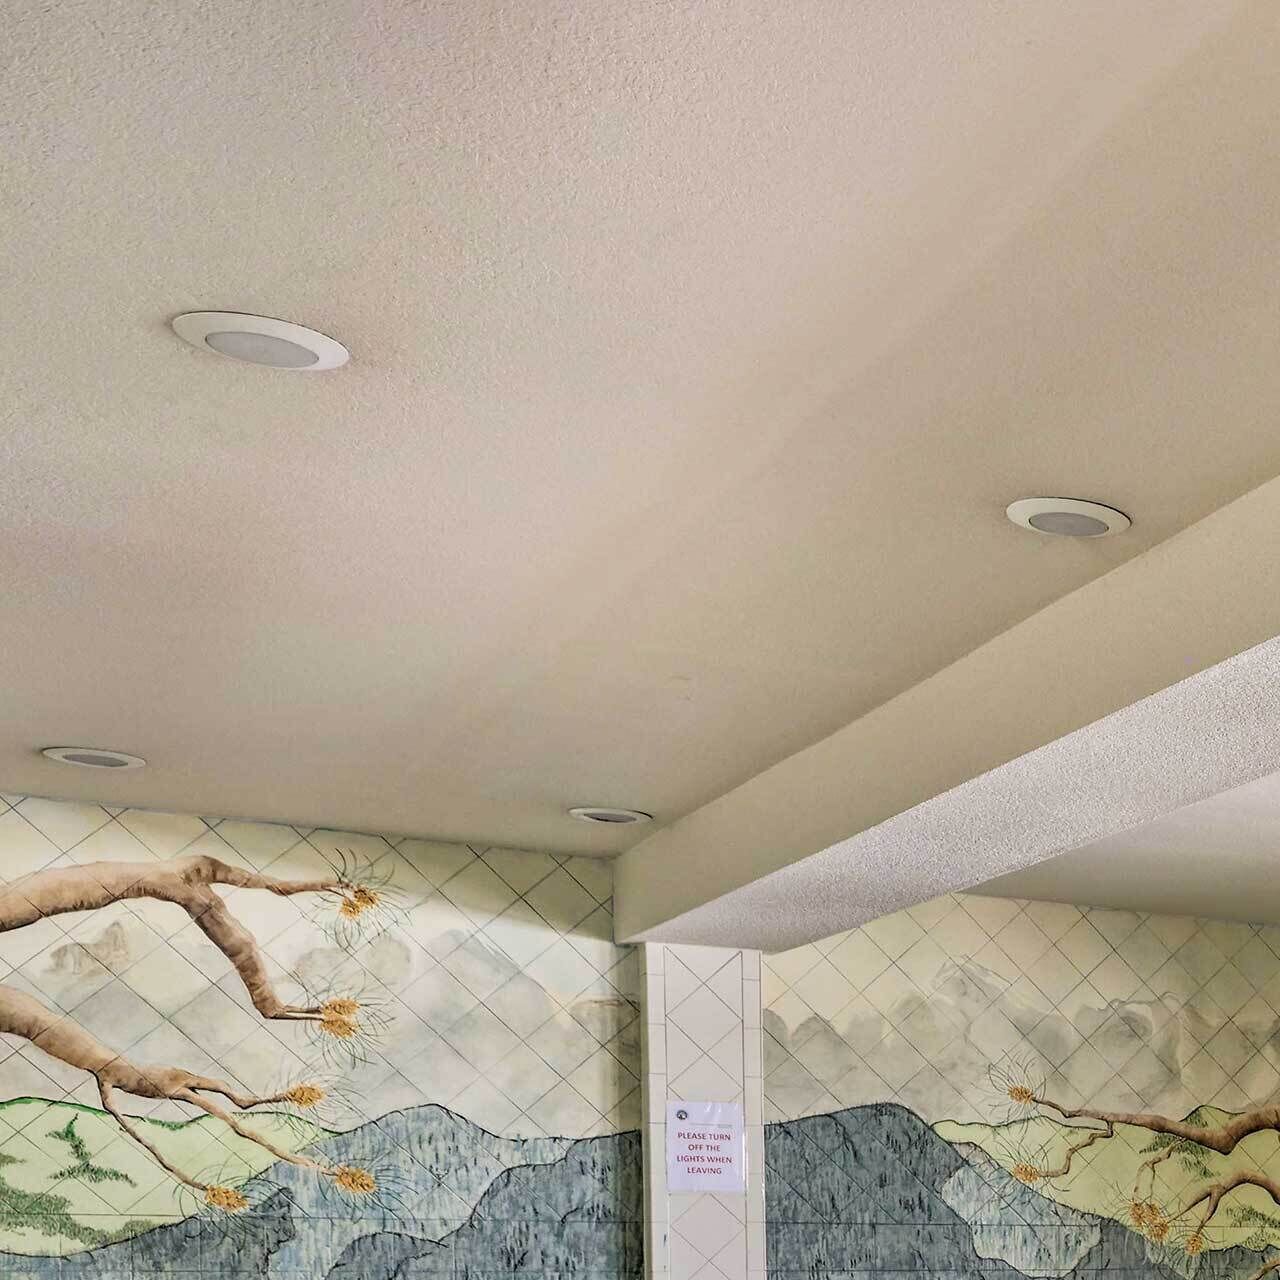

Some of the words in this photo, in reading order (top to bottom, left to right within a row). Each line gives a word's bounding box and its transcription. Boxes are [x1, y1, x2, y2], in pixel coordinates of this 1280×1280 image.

[677, 1132, 707, 1140] PLEASE
[709, 1133, 731, 1141] TURN
[706, 1144, 721, 1152] THE
[677, 1155, 705, 1163] LIGHTS
